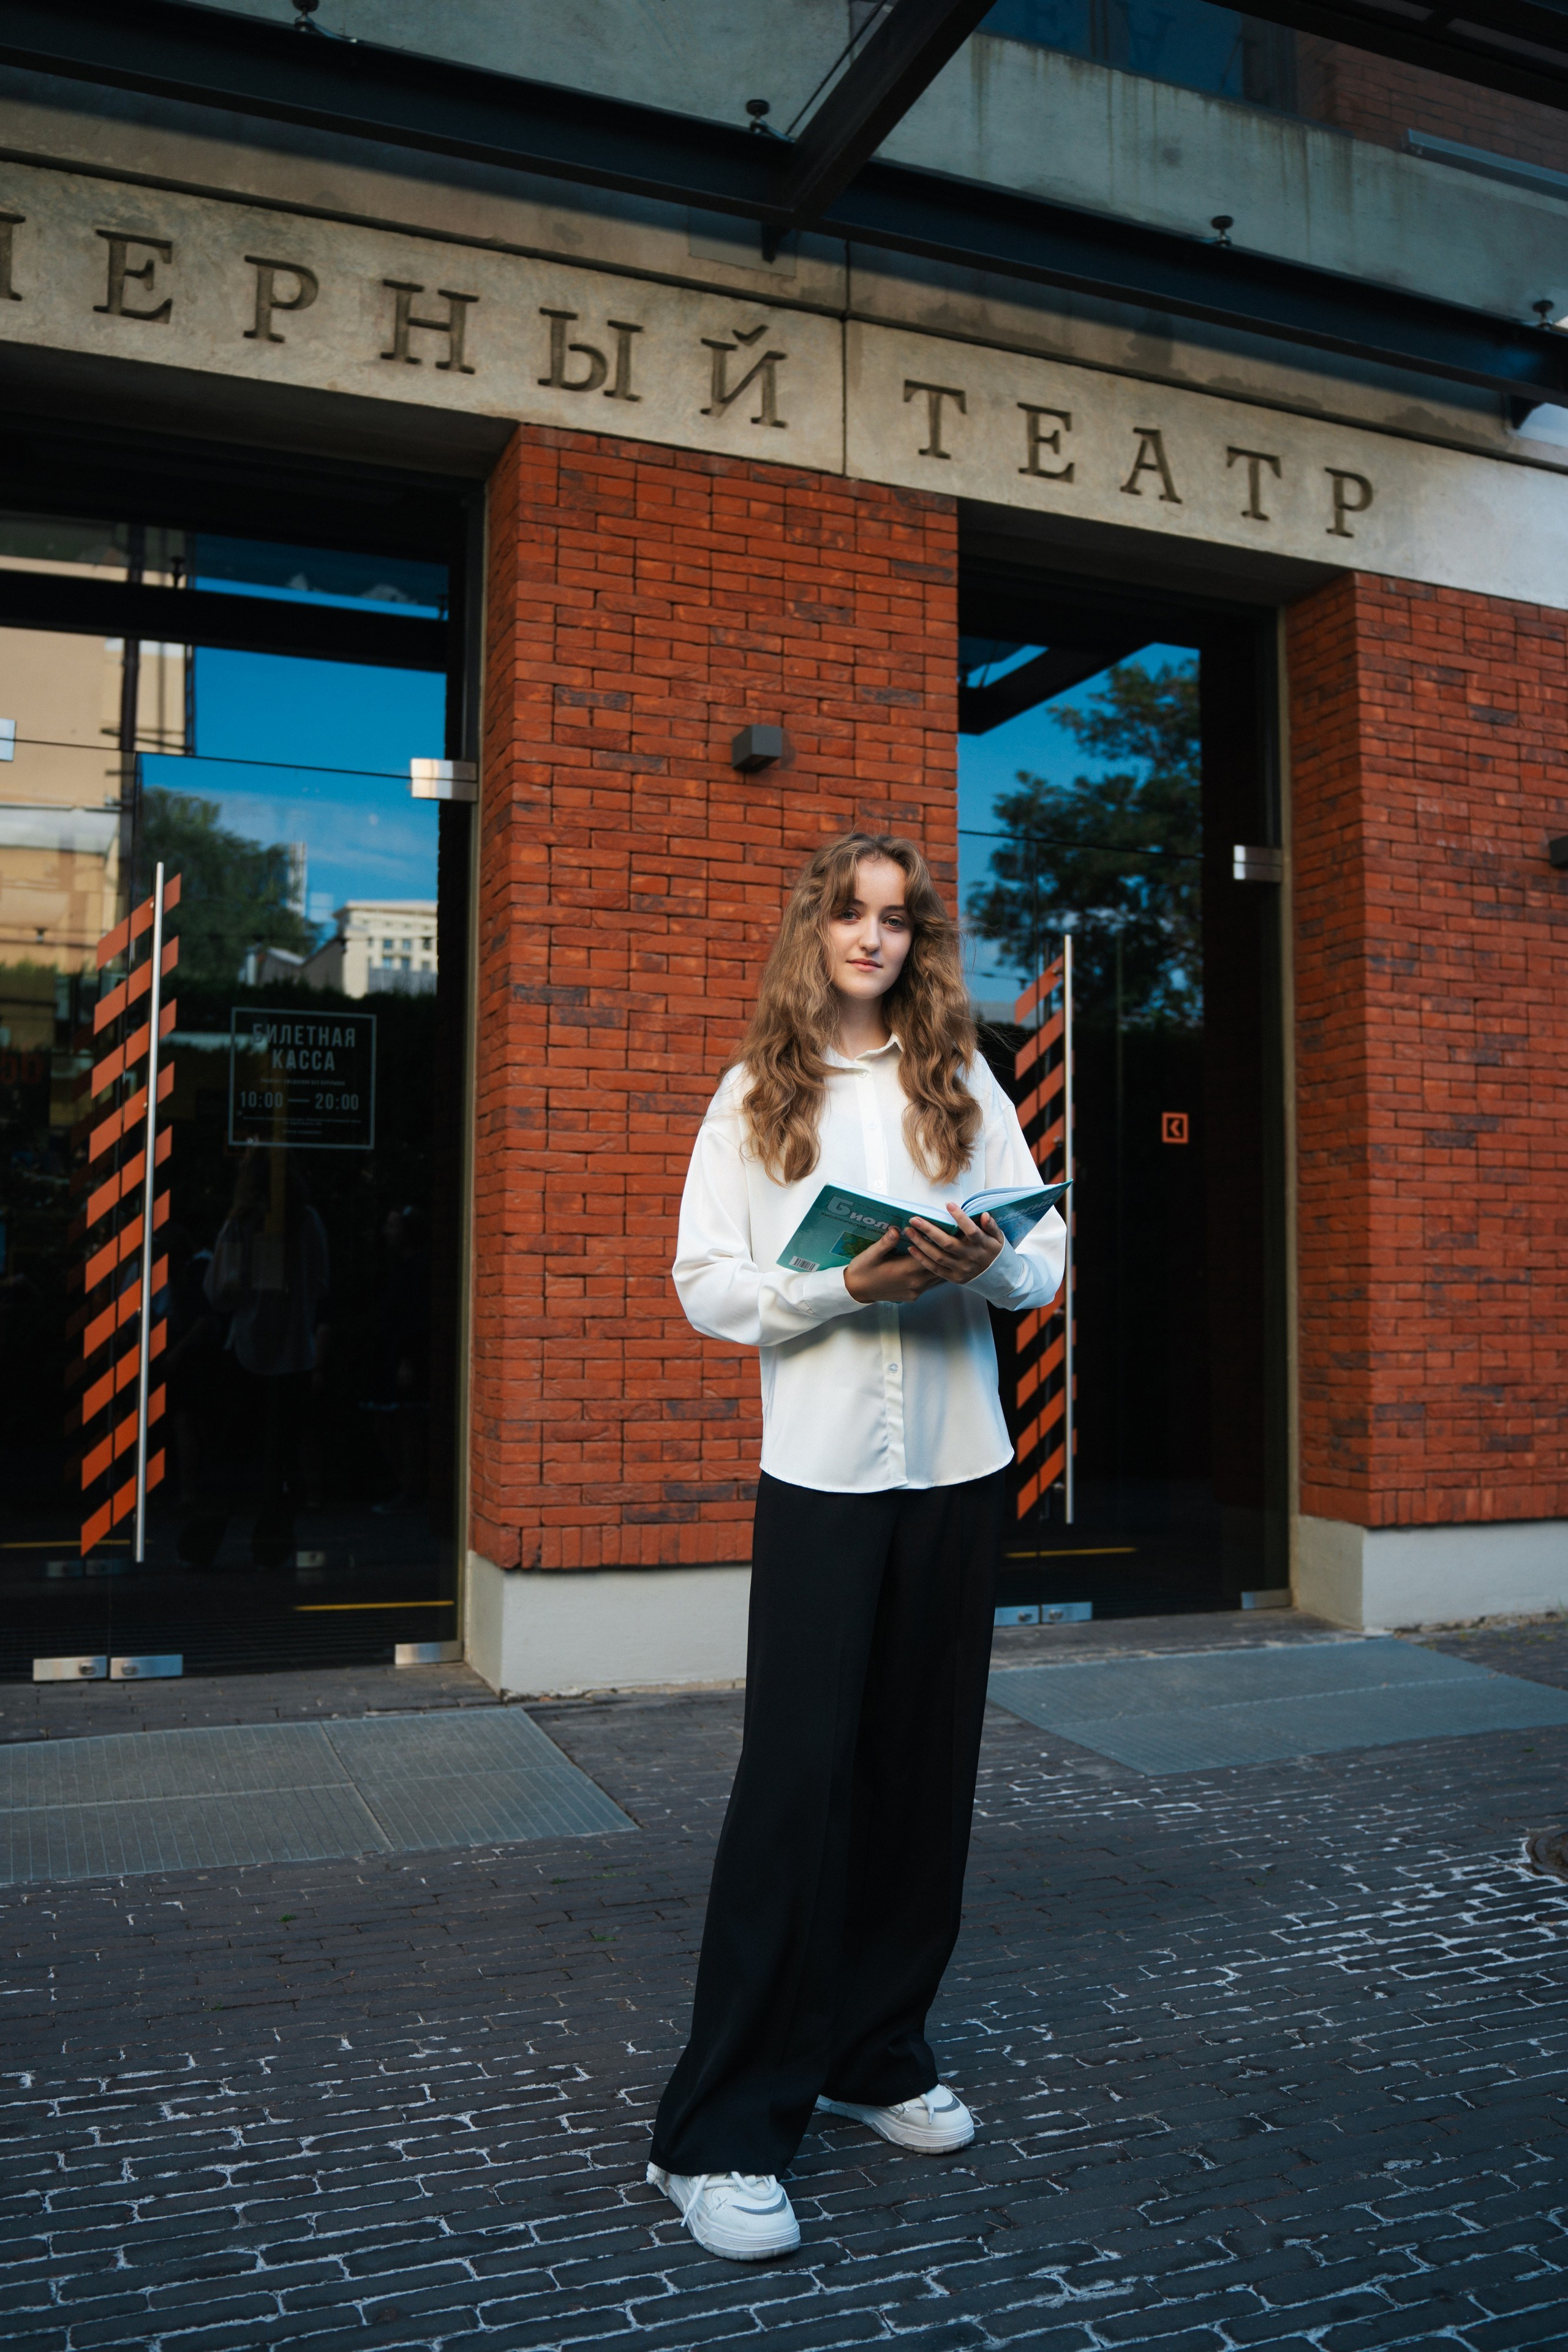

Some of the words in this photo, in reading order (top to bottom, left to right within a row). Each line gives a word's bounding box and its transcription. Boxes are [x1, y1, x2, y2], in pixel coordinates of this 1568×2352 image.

[903, 379, 1374, 538] ТЕАТР
[252, 1023, 356, 1047] БИЛЕТНАЯ
[272, 1049, 335, 1071] КАССА
[241, 1091, 284, 1108] 10:00
[315, 1093, 360, 1110] 20:00
